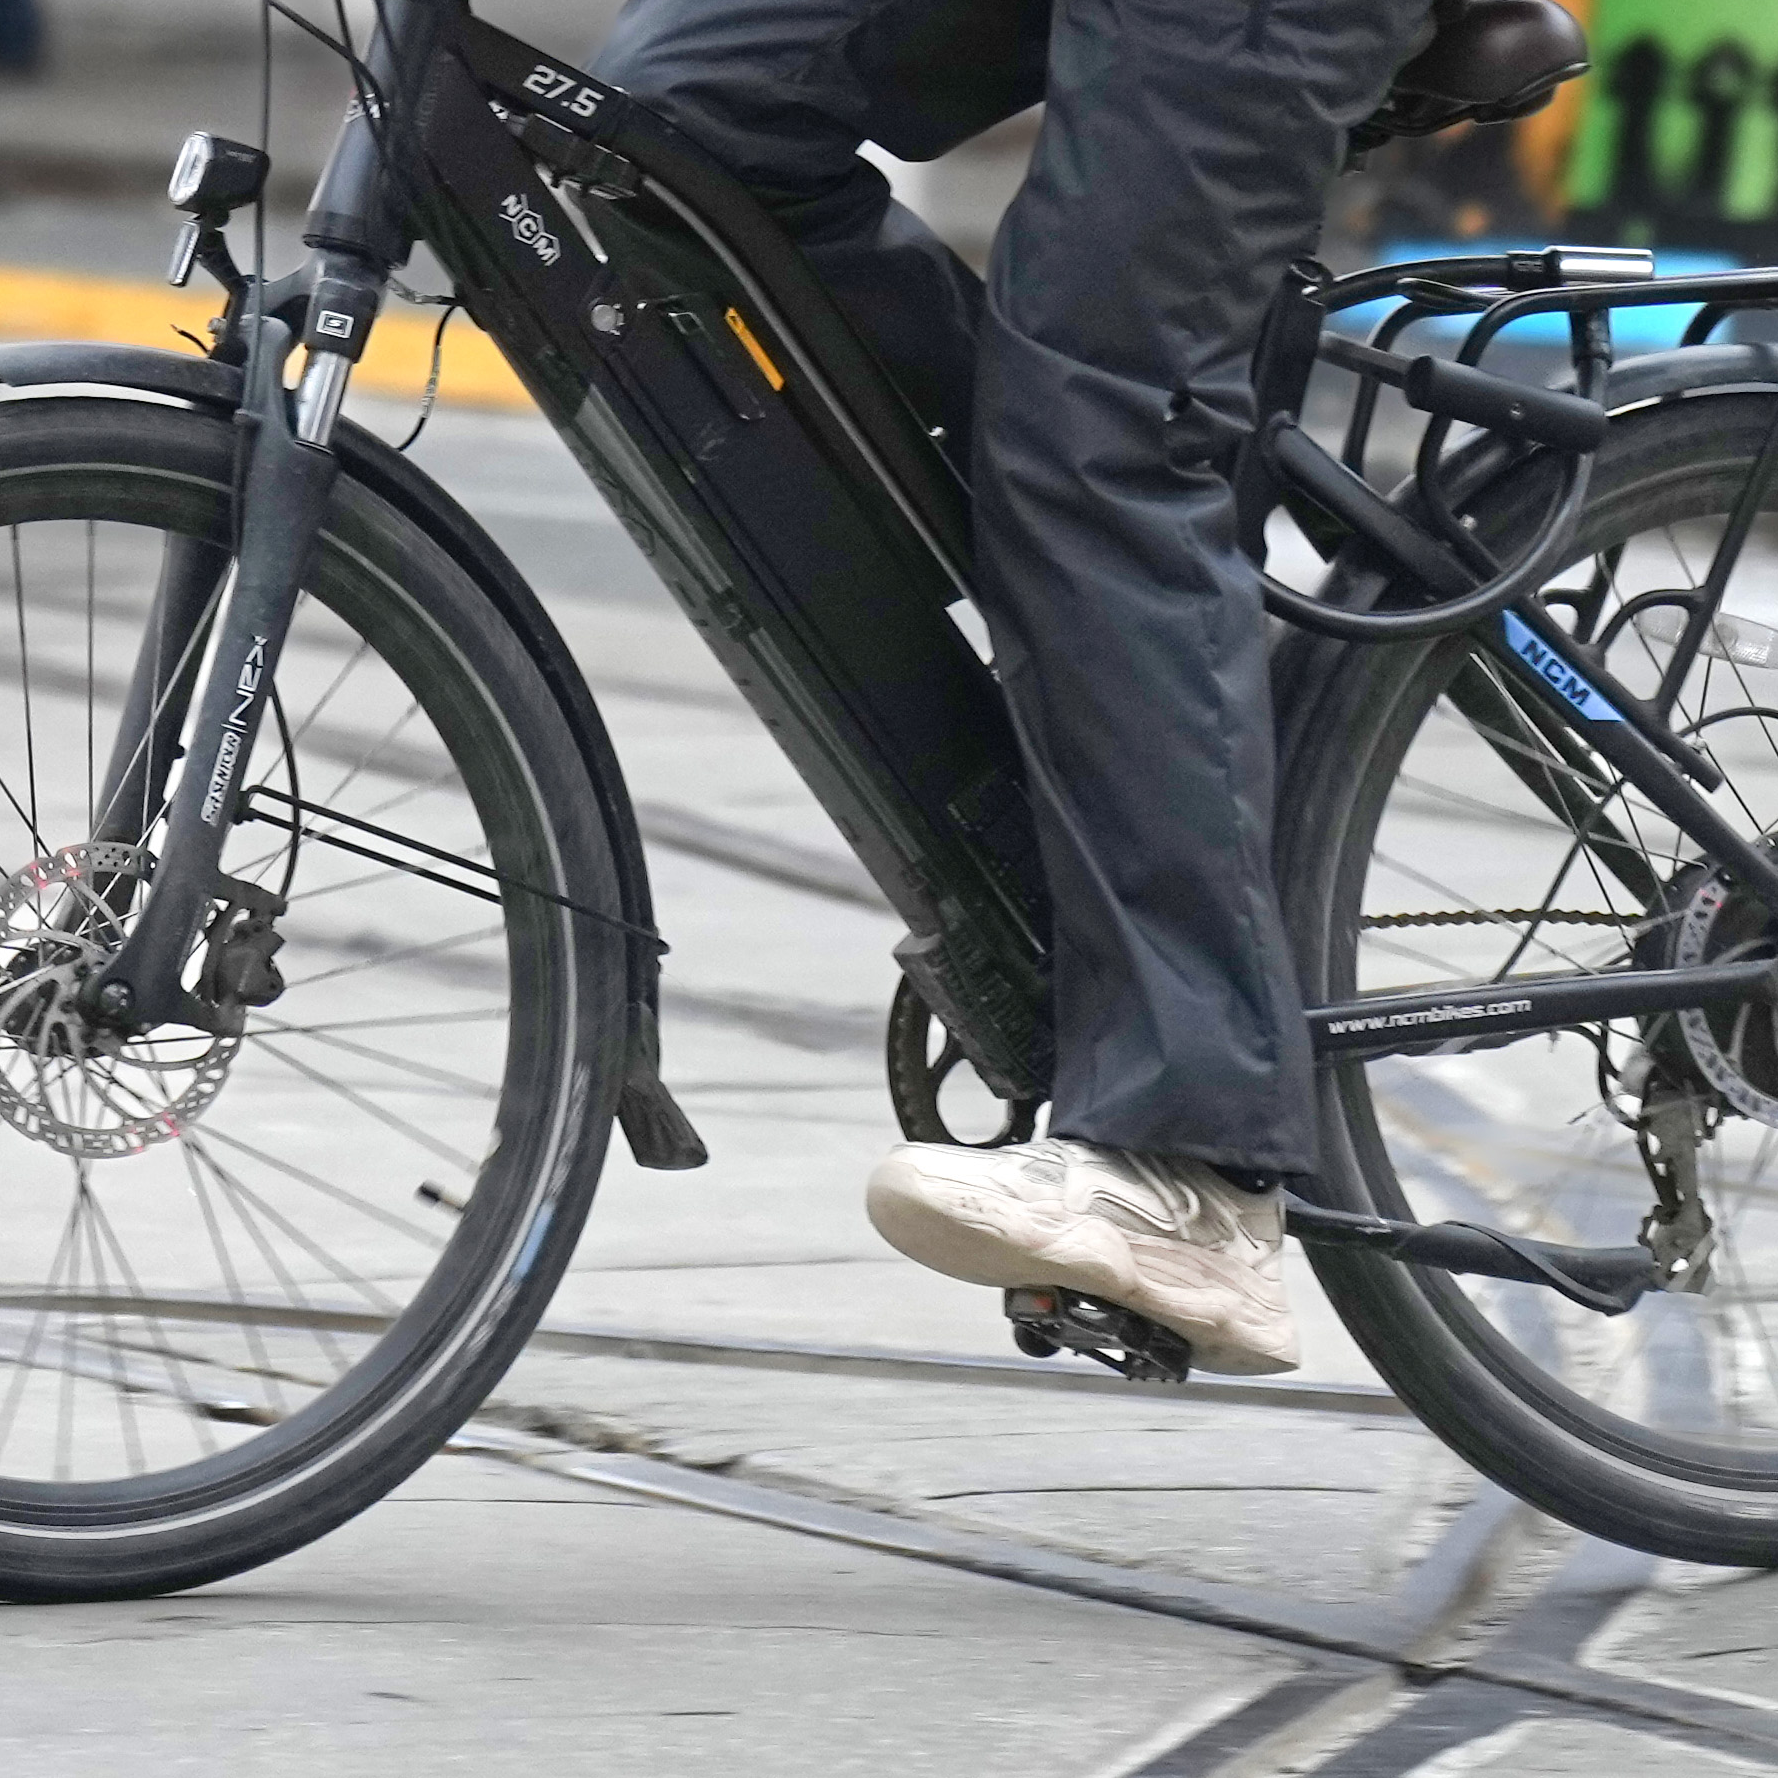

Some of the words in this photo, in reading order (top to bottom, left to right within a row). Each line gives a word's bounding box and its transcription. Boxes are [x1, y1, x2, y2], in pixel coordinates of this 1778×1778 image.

[522, 64, 605, 118] 27.5
[499, 193, 562, 266] NCM
[1521, 638, 1592, 707] NCM
